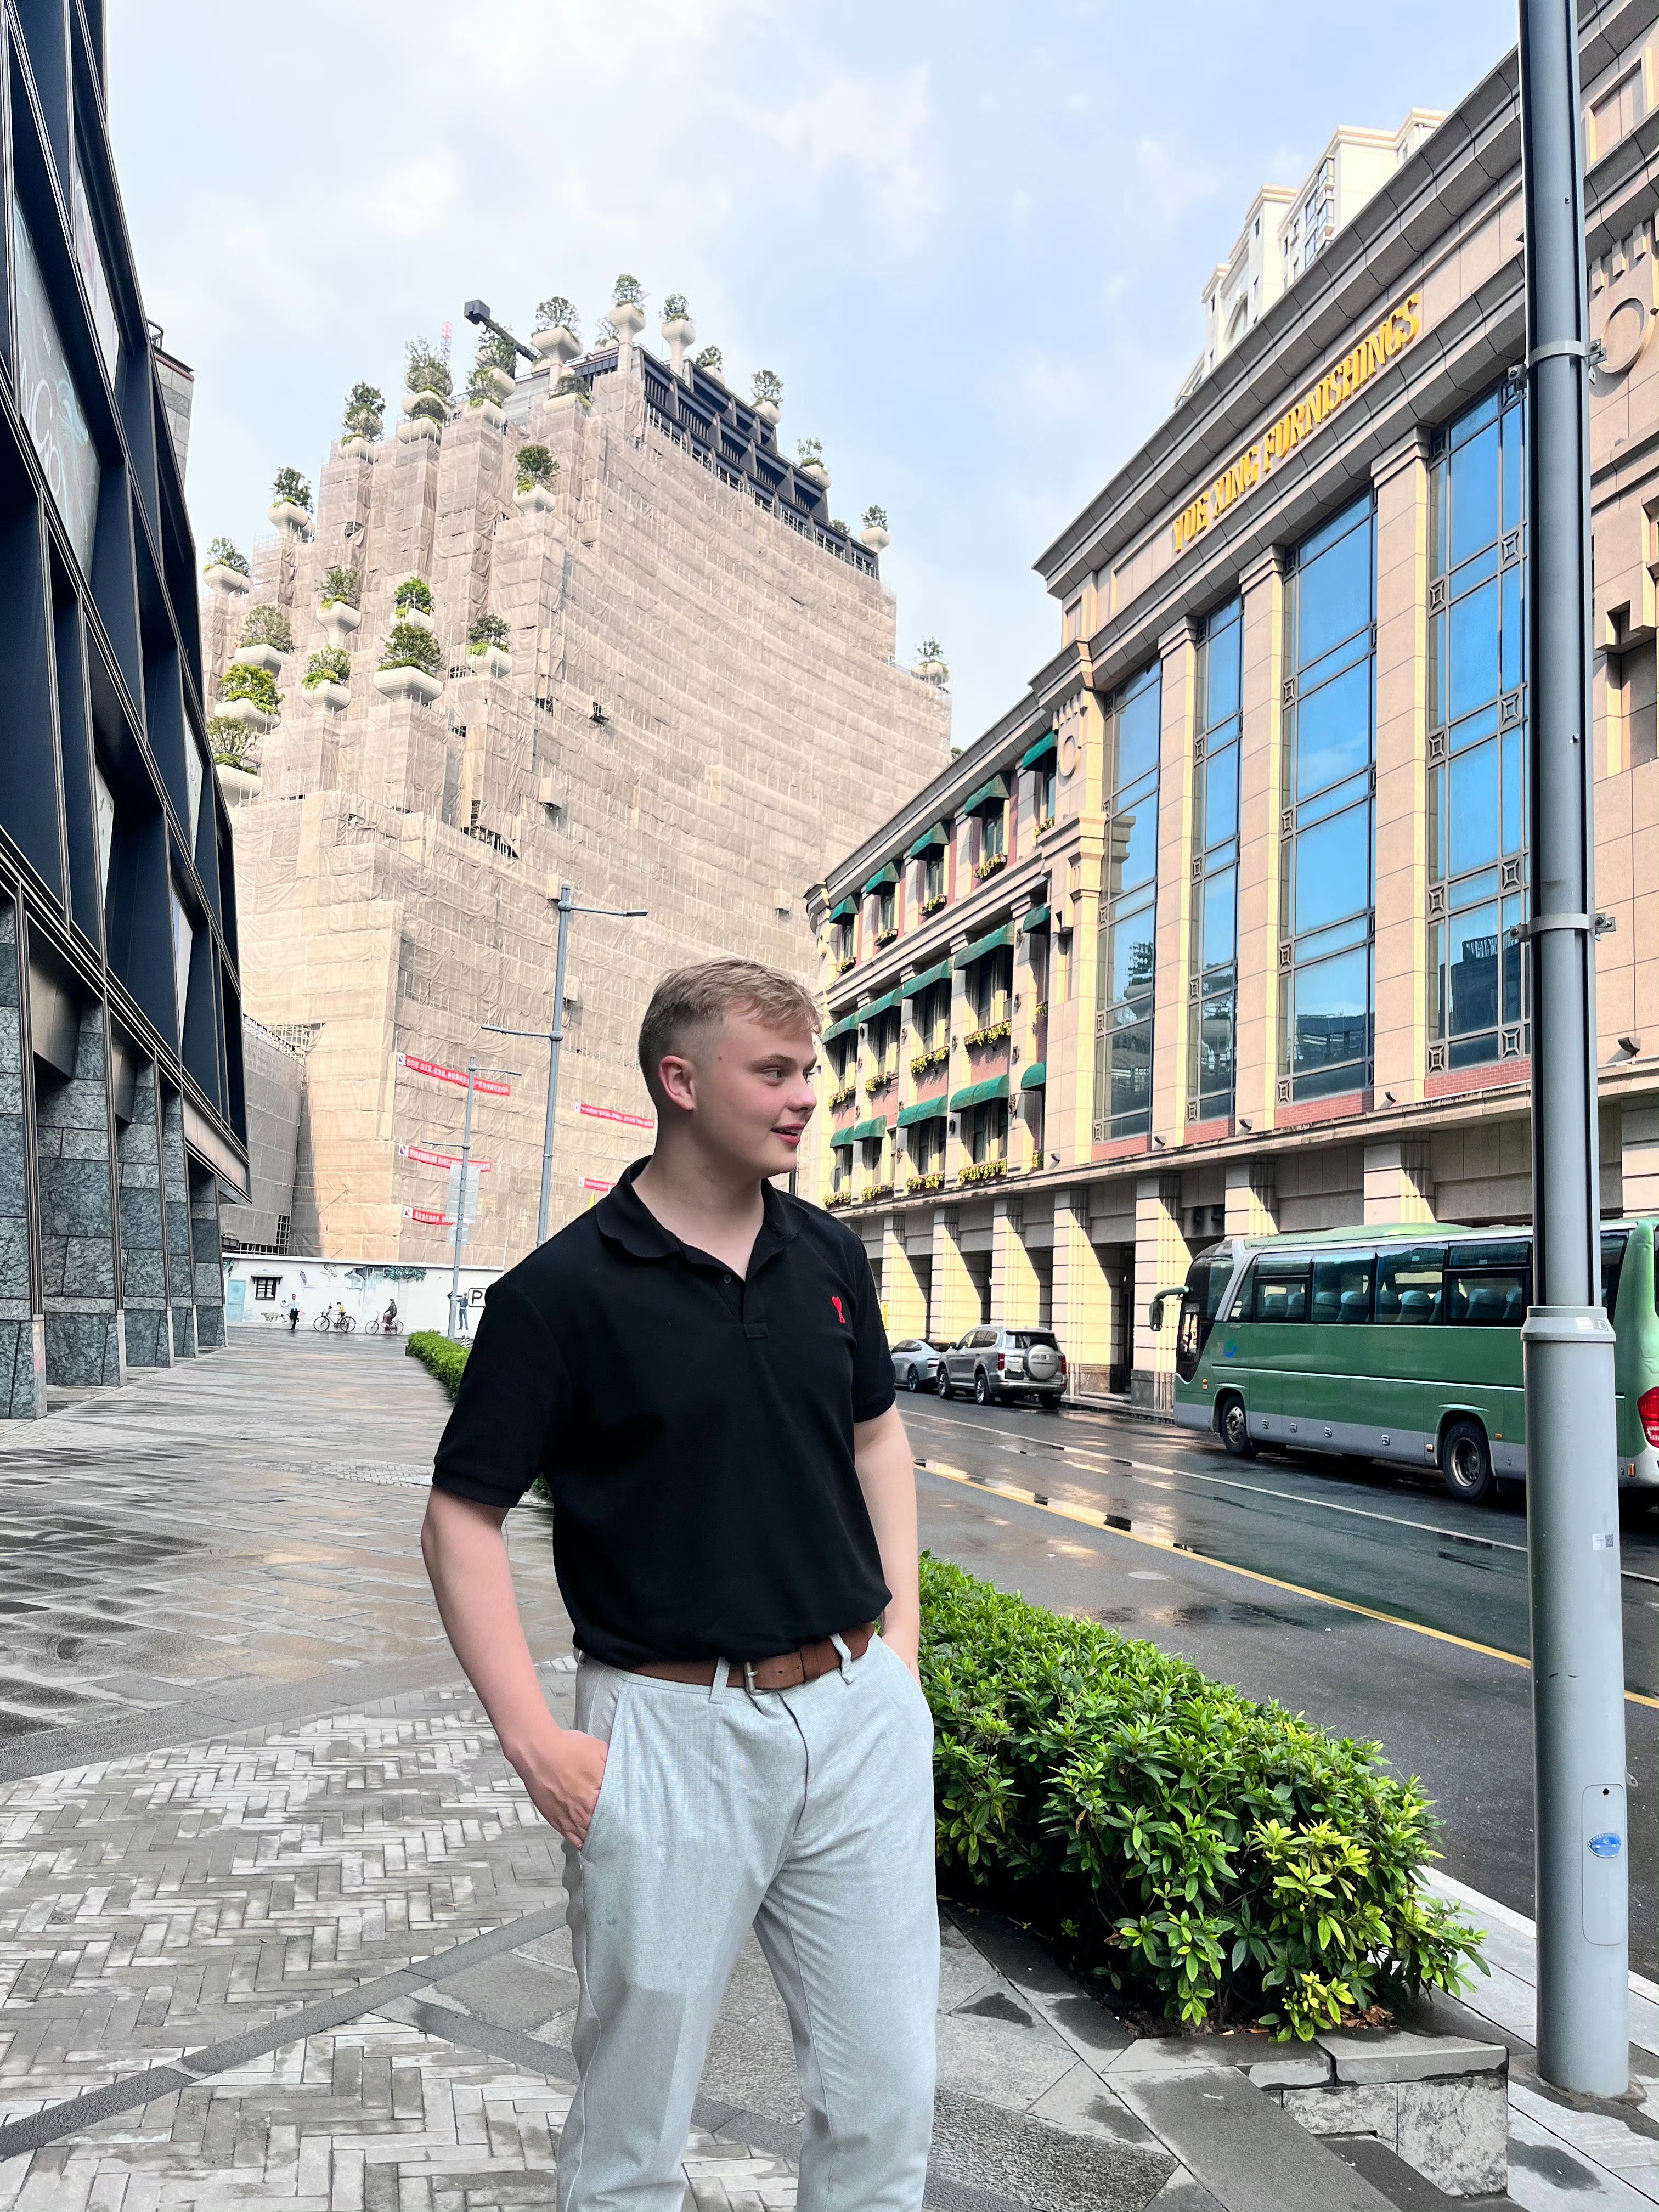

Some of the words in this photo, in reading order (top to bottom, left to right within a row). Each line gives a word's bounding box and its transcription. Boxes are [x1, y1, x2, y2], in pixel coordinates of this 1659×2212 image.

[1172, 492, 1209, 552] YUE
[1212, 445, 1258, 519] XING
[1263, 293, 1419, 472] FURNISHINGS
[472, 1290, 483, 1305] P
